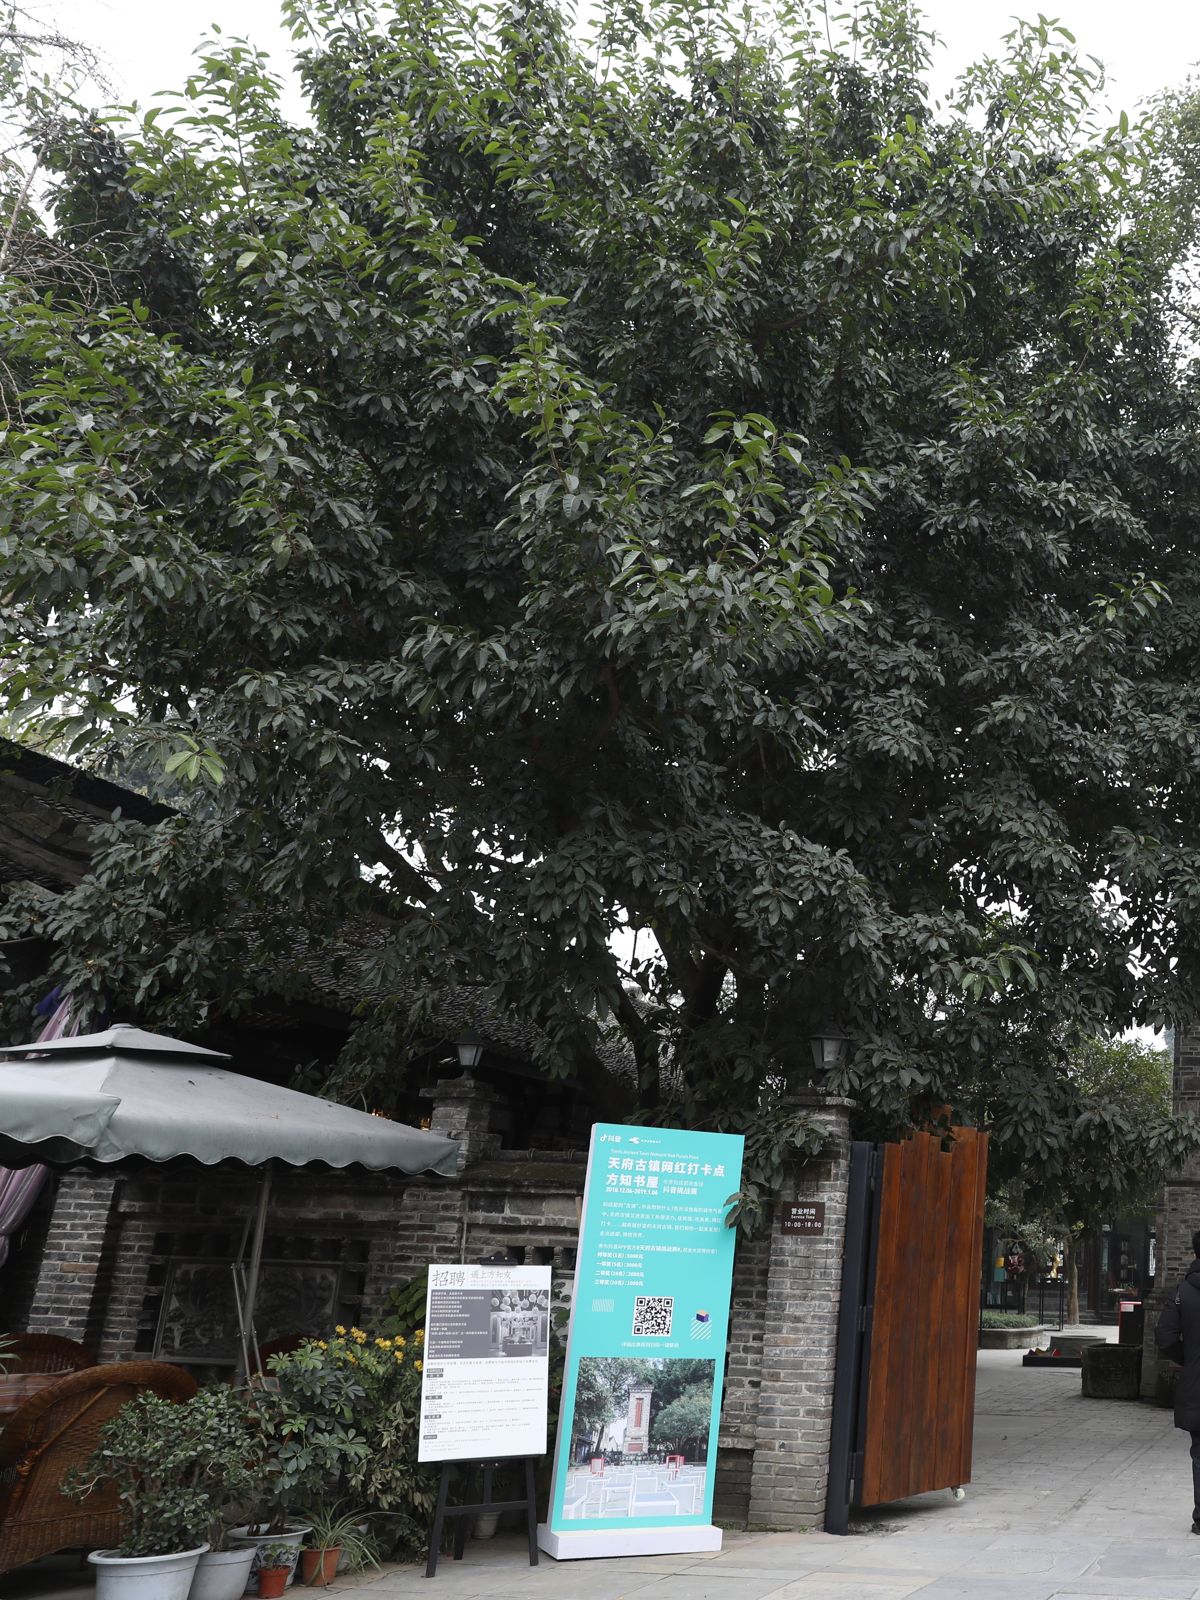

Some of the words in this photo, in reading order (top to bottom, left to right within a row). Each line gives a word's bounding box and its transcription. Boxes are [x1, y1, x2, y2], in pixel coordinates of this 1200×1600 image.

[608, 1157, 725, 1177] 天府古镇网红打卡点
[606, 1173, 659, 1188] 方知书屋
[432, 1270, 466, 1287] 招聘
